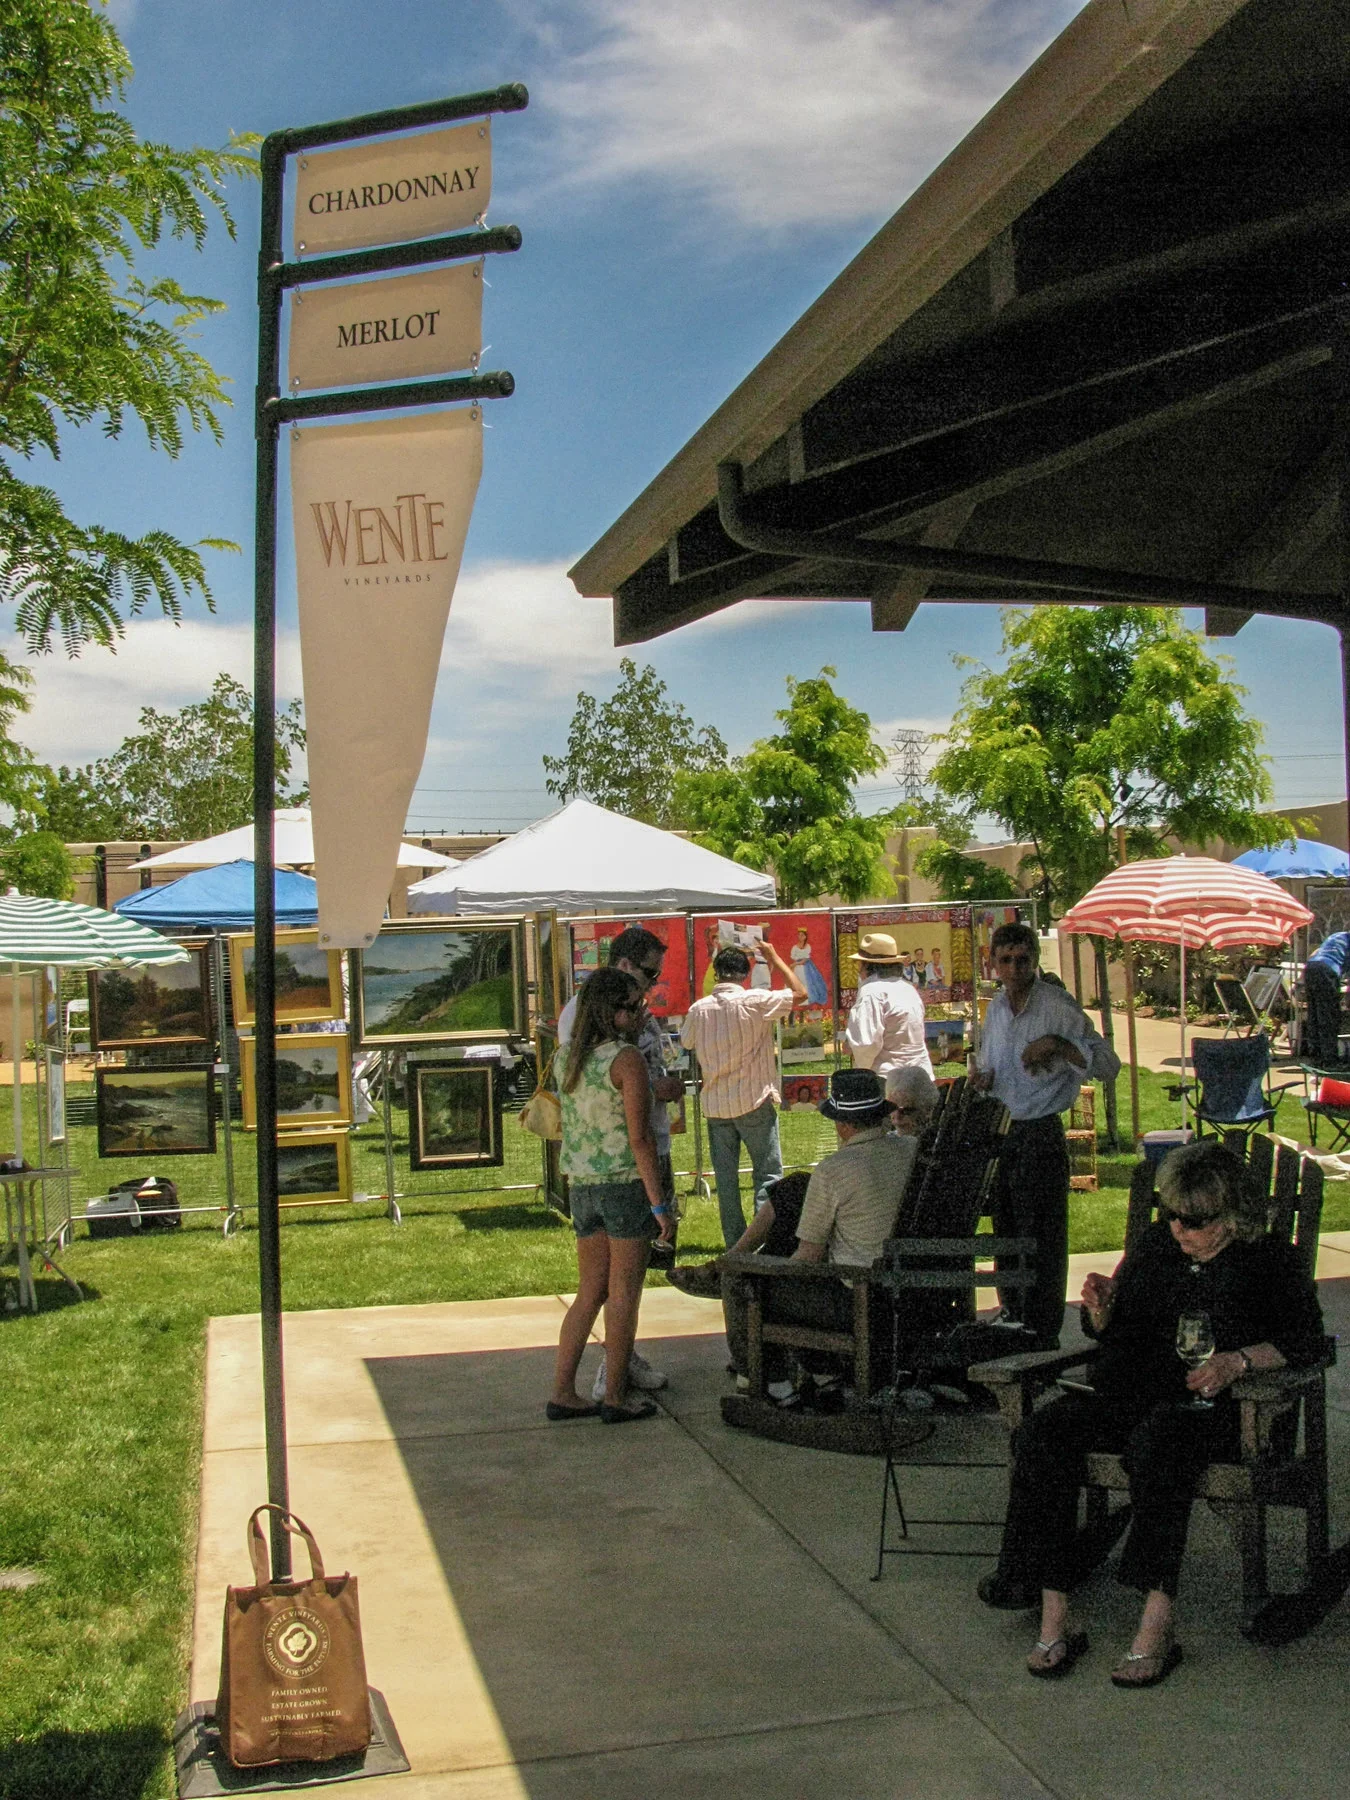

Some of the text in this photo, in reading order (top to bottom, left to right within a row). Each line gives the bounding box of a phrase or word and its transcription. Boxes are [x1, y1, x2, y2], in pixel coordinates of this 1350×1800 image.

[308, 166, 479, 215] CHARDONNAY
[336, 310, 440, 348] MERLOT
[309, 493, 449, 568] WENTE
[344, 574, 432, 586] VINEYARDS
[267, 1614, 287, 1638] WENTE
[285, 1668, 300, 1676] FOR
[301, 1664, 314, 1675] THE
[271, 1686, 328, 1697] FAMILY OWNED
[271, 1698, 328, 1709] ESTATE GROWN
[261, 1709, 341, 1723] SUSTAINABLY FARMED
